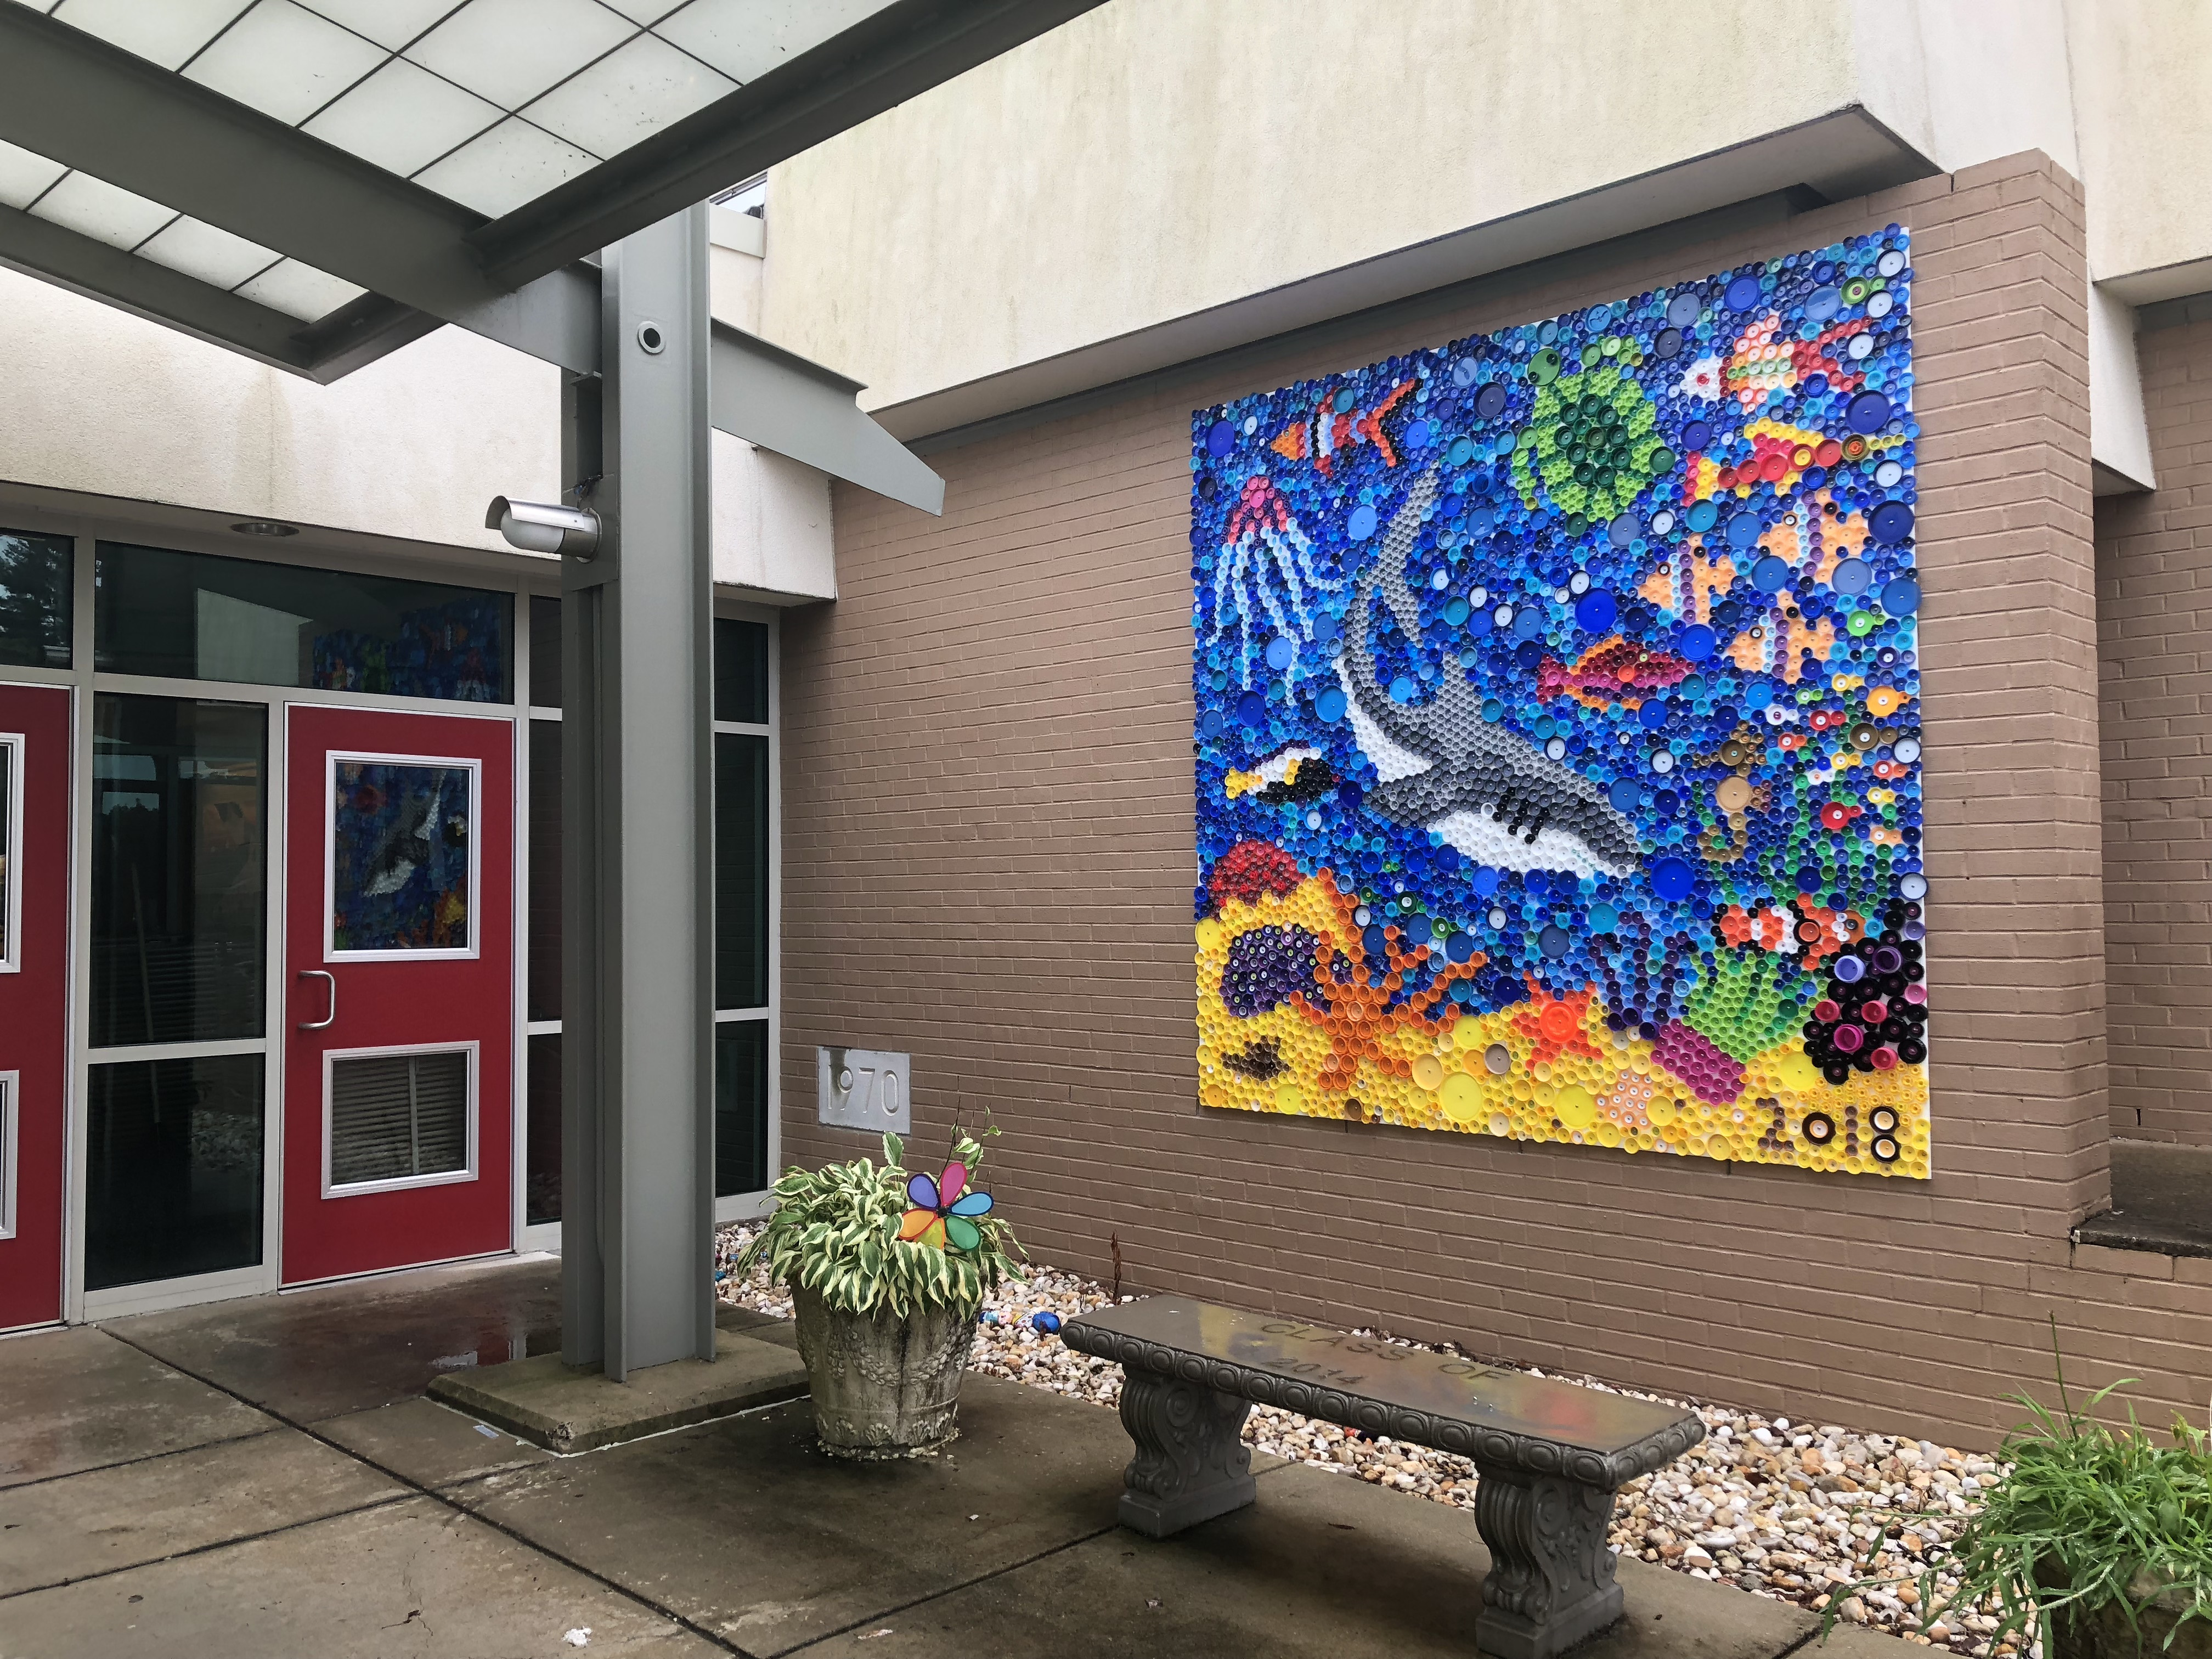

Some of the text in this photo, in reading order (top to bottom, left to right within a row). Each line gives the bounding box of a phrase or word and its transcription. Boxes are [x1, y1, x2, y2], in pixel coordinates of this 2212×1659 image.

[827, 1064, 899, 1117] 1970
[1755, 1097, 1901, 1165] 2018
[1260, 1357, 1369, 1385] 2014
[1261, 1323, 1512, 1380] CLASS OF
